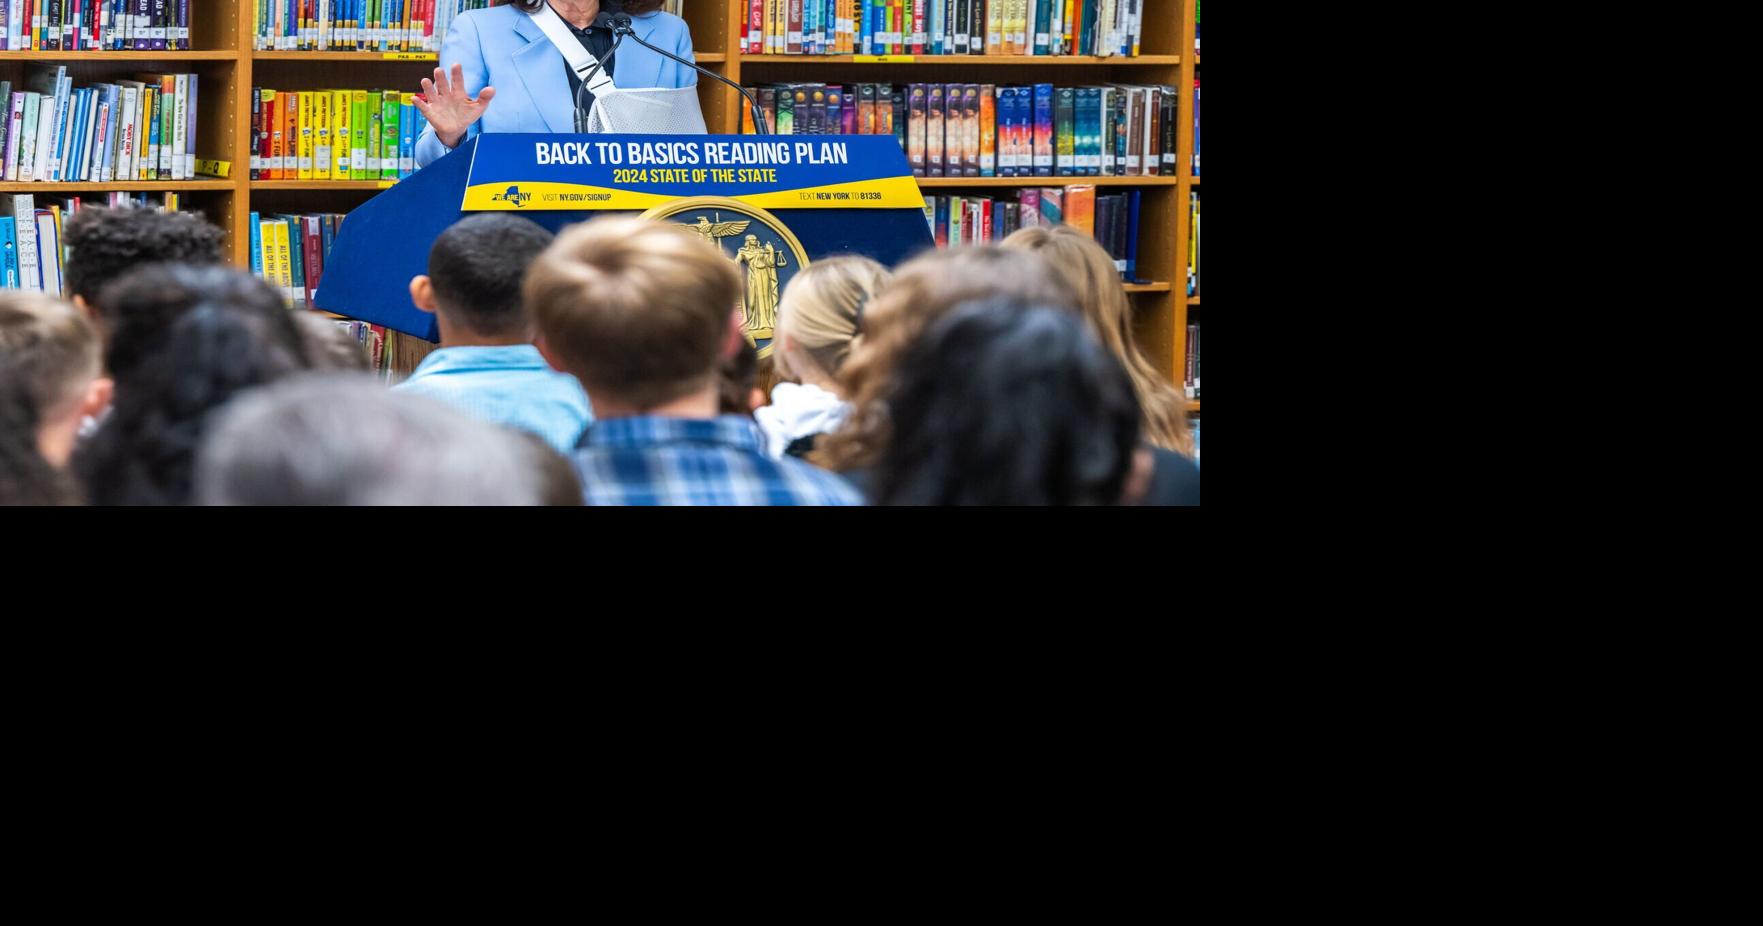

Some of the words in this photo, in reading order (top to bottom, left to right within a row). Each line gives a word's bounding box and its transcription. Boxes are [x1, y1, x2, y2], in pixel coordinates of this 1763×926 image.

[536, 142, 592, 165] BACK
[594, 142, 623, 165] TO
[627, 142, 700, 165] BASICS
[704, 142, 791, 165] READING
[795, 142, 848, 164] PLAN
[613, 168, 649, 184] 2024
[650, 168, 690, 184] STATE
[692, 168, 708, 183] OF
[710, 168, 735, 183] THE
[738, 168, 778, 183] STATE
[519, 193, 532, 201] NY
[559, 193, 612, 201] NY.GOV/SIGNUP
[799, 192, 815, 200] TEXT
[816, 192, 832, 200] NEW
[832, 192, 851, 200] YORK
[851, 192, 860, 200] TO
